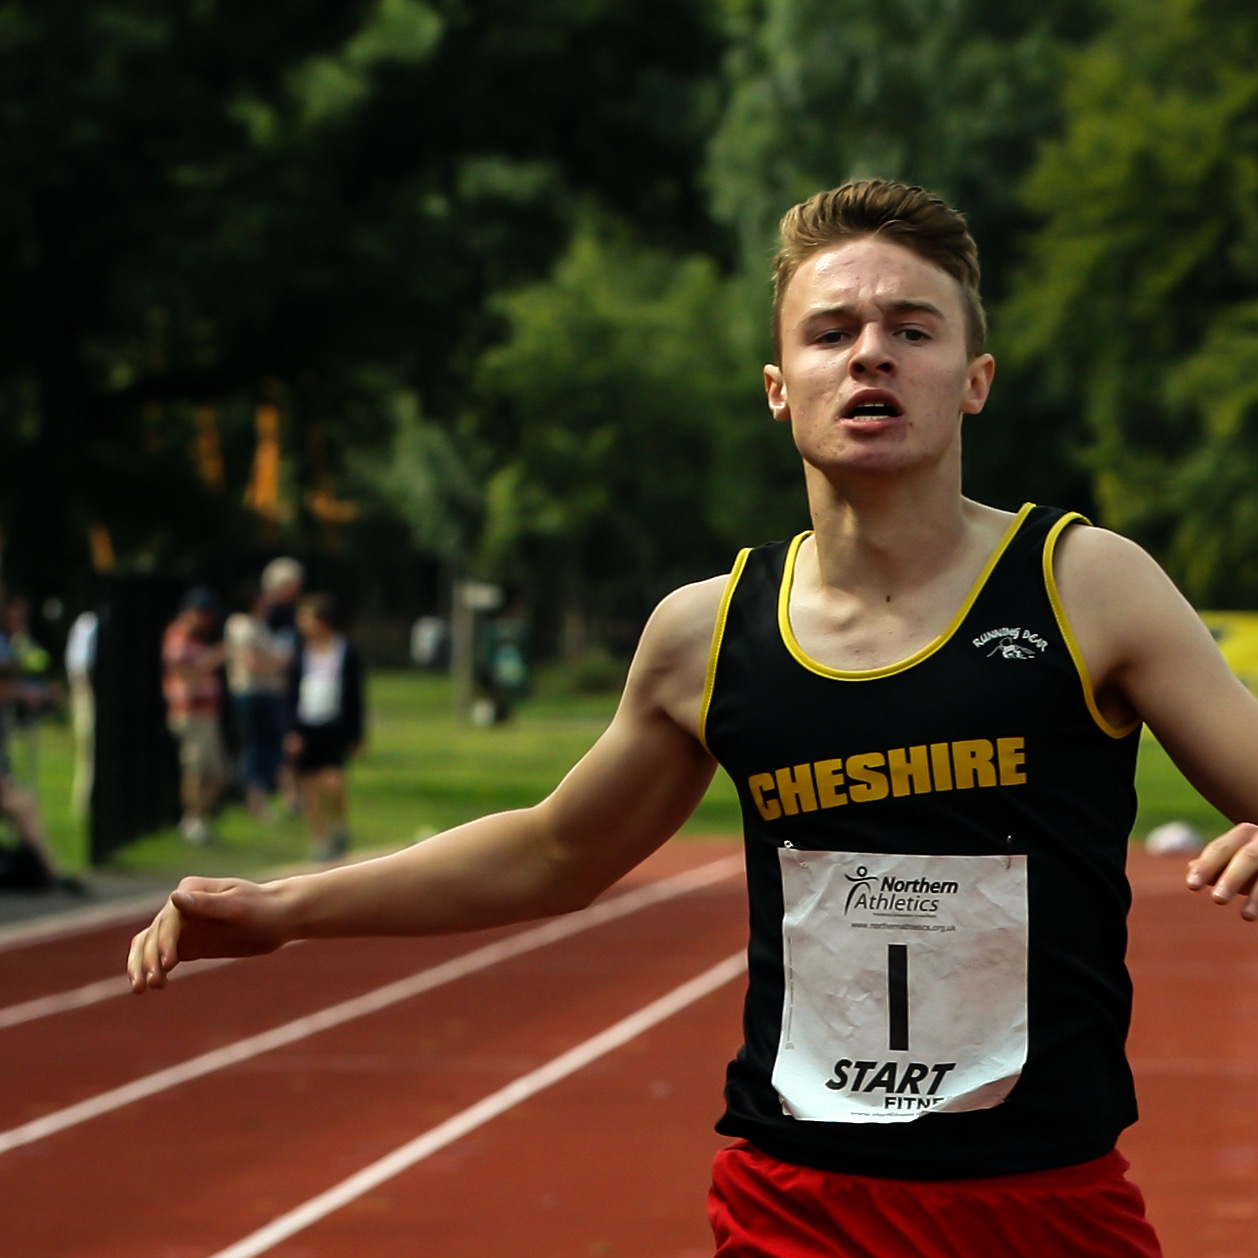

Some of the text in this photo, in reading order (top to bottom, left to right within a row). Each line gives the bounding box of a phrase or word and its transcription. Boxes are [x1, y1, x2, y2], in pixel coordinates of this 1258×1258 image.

[748, 736, 1027, 821] CHESHIRE
[854, 893, 939, 912] Athletics
[880, 877, 959, 894] Northern
[888, 944, 909, 1051] 1
[825, 1058, 957, 1096] START
